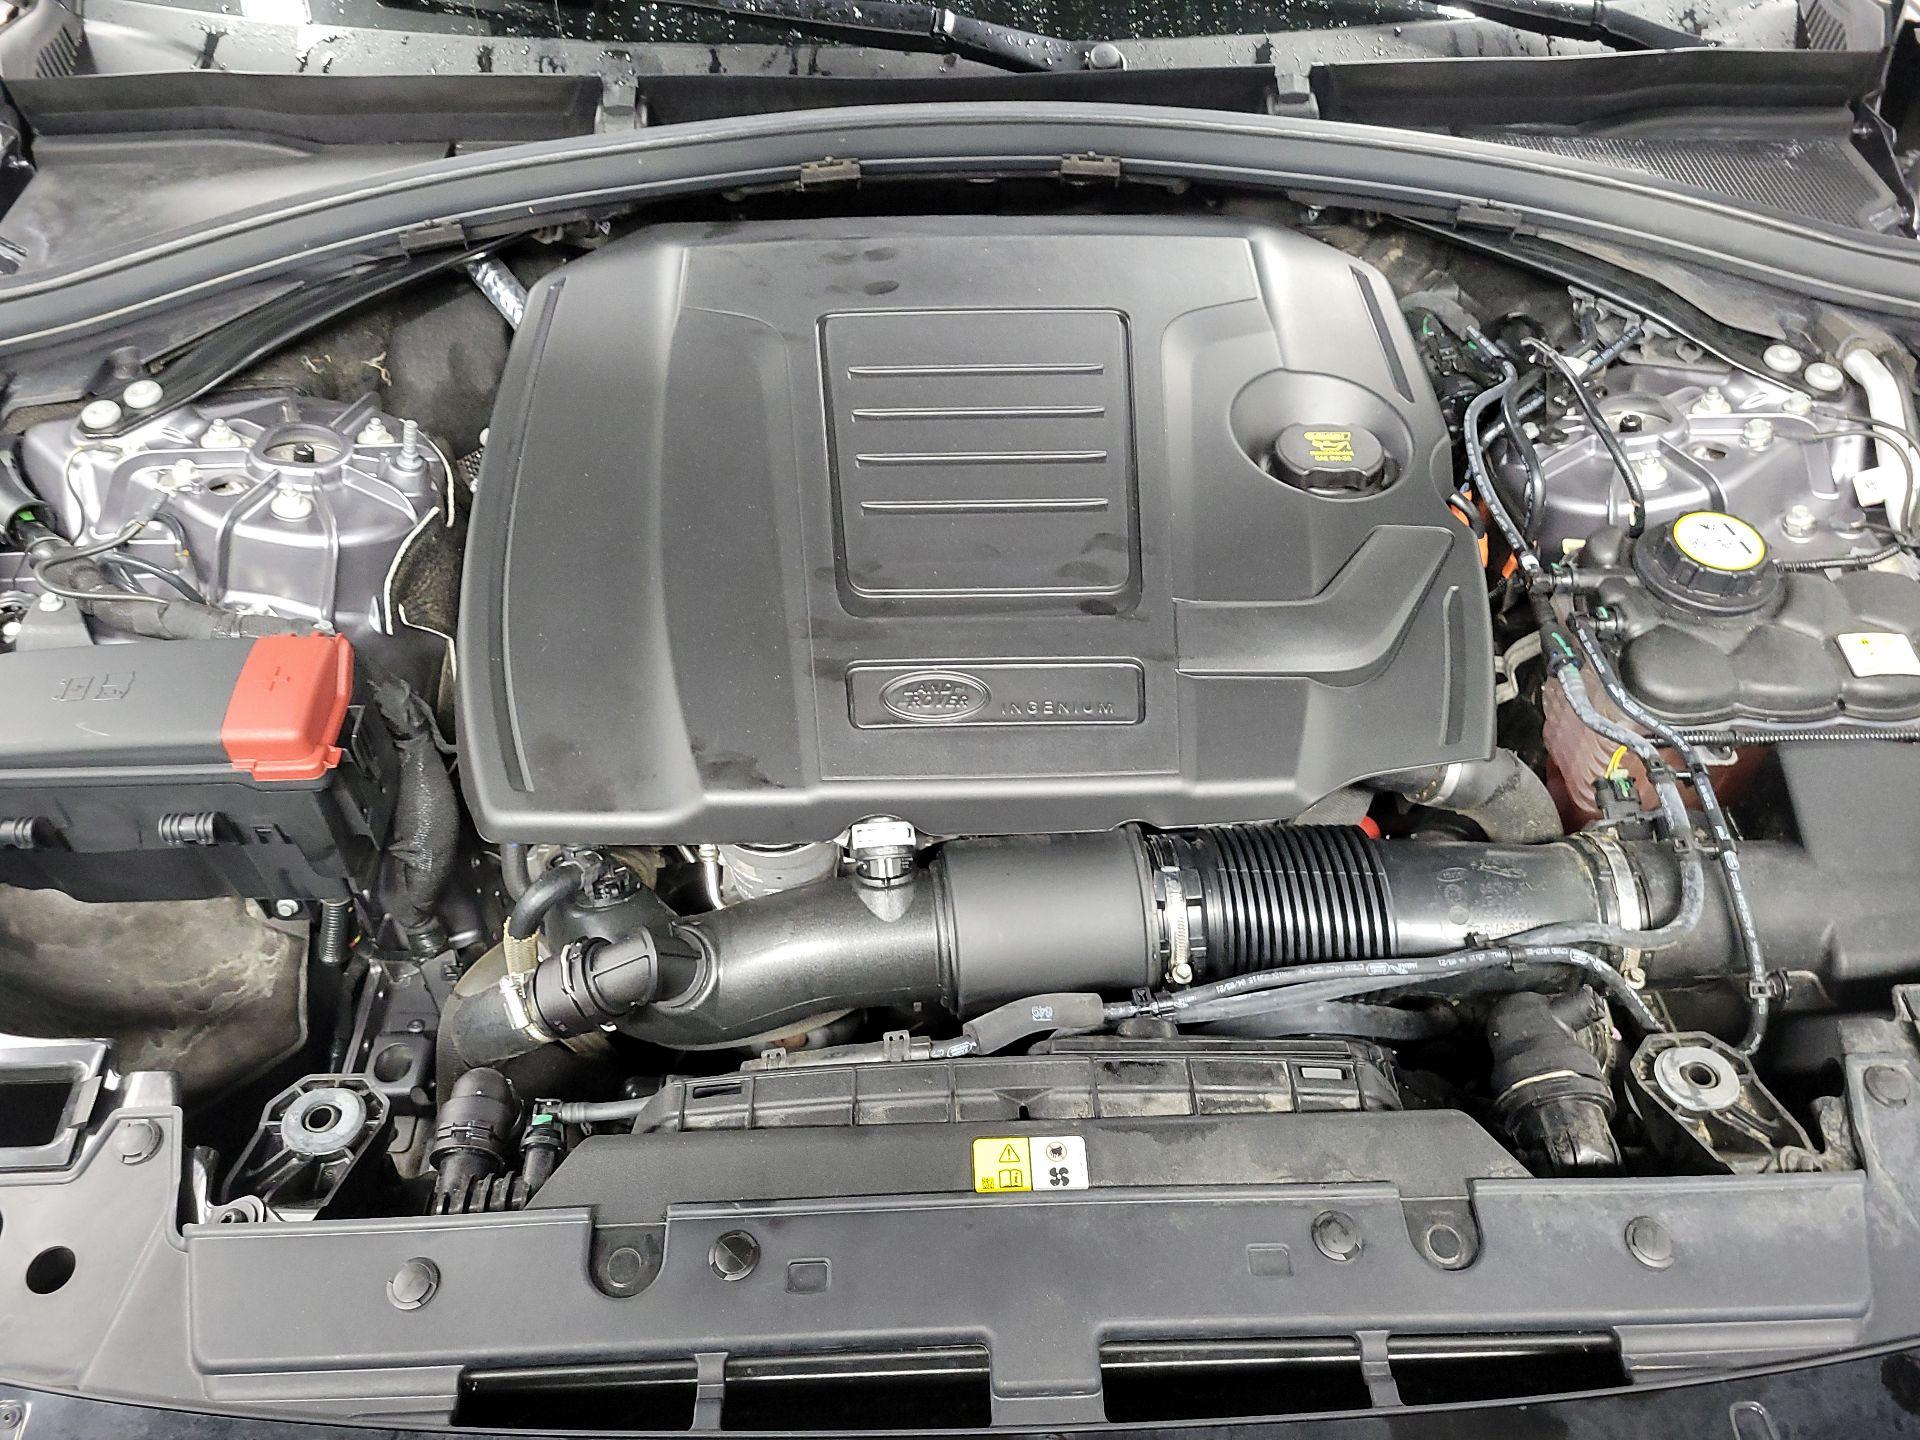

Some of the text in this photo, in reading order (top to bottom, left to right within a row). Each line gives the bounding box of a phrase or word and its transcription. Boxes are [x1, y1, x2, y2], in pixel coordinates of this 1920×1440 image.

[903, 683, 952, 696] LAND
[906, 695, 969, 709] ROVER
[1001, 700, 1115, 716] INGENIUM
